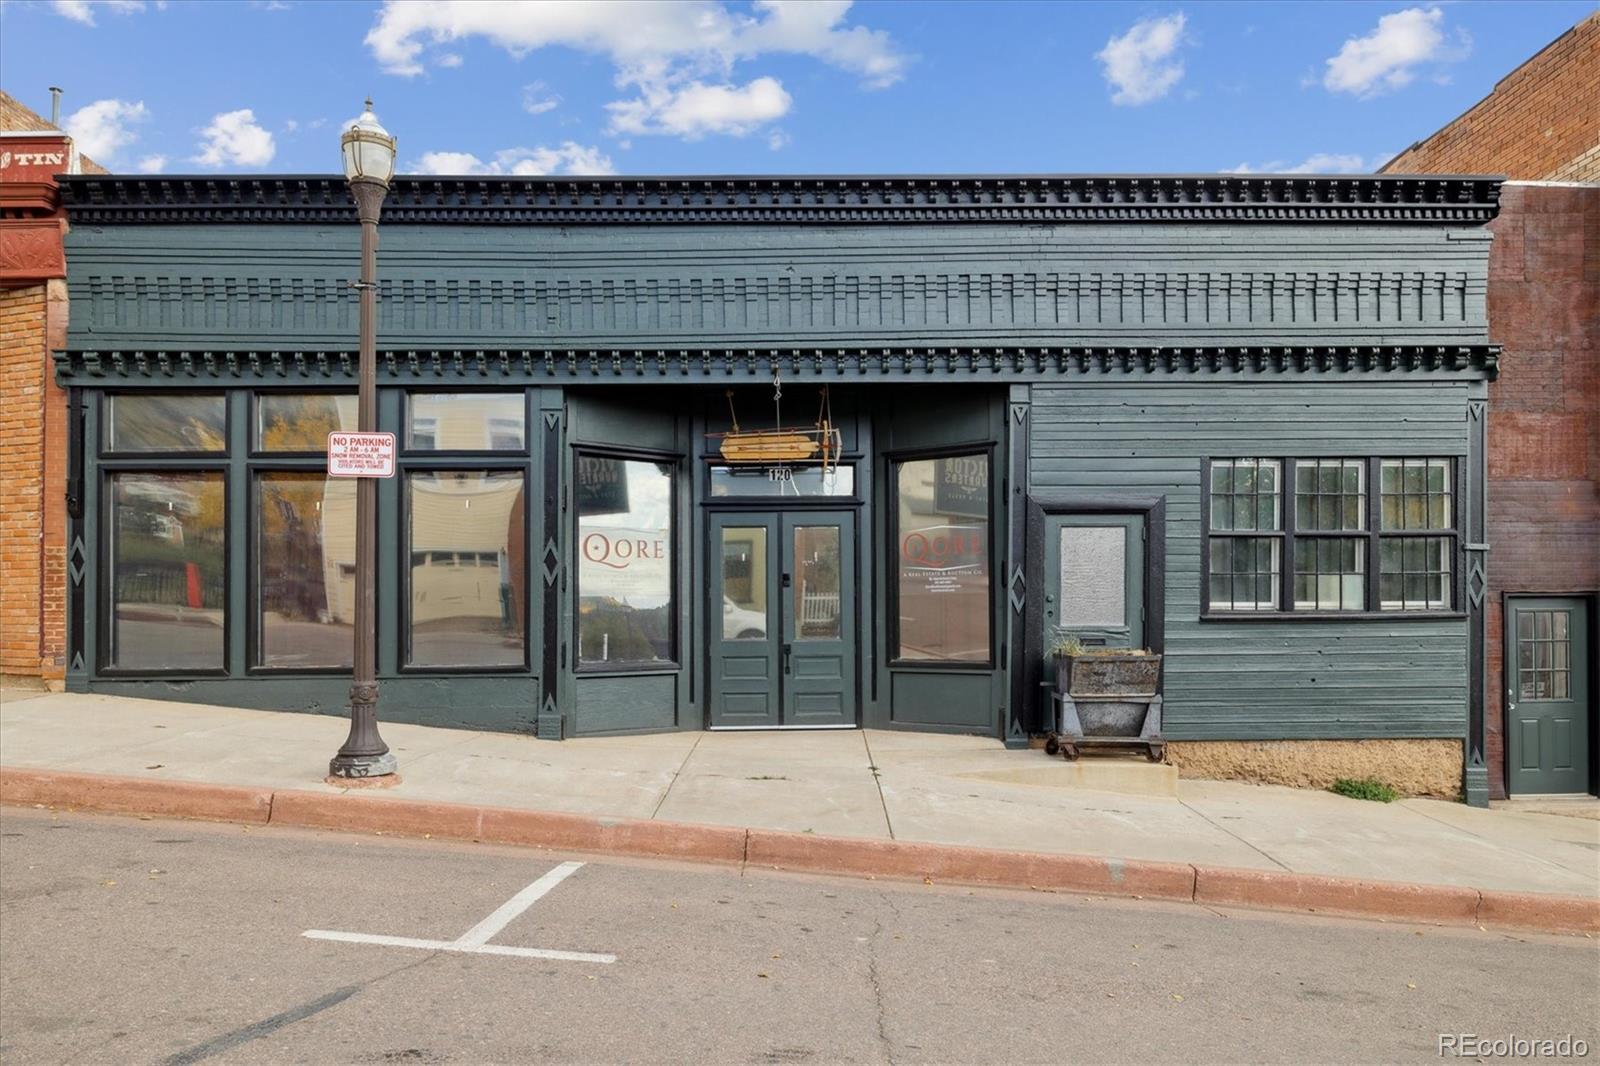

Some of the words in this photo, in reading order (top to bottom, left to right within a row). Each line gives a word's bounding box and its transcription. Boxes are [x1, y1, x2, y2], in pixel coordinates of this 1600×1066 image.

[14, 152, 64, 166] TIN
[333, 437, 347, 446] NO
[350, 438, 391, 447] PARKING
[769, 469, 791, 481] 120
[583, 533, 664, 569] QORE
